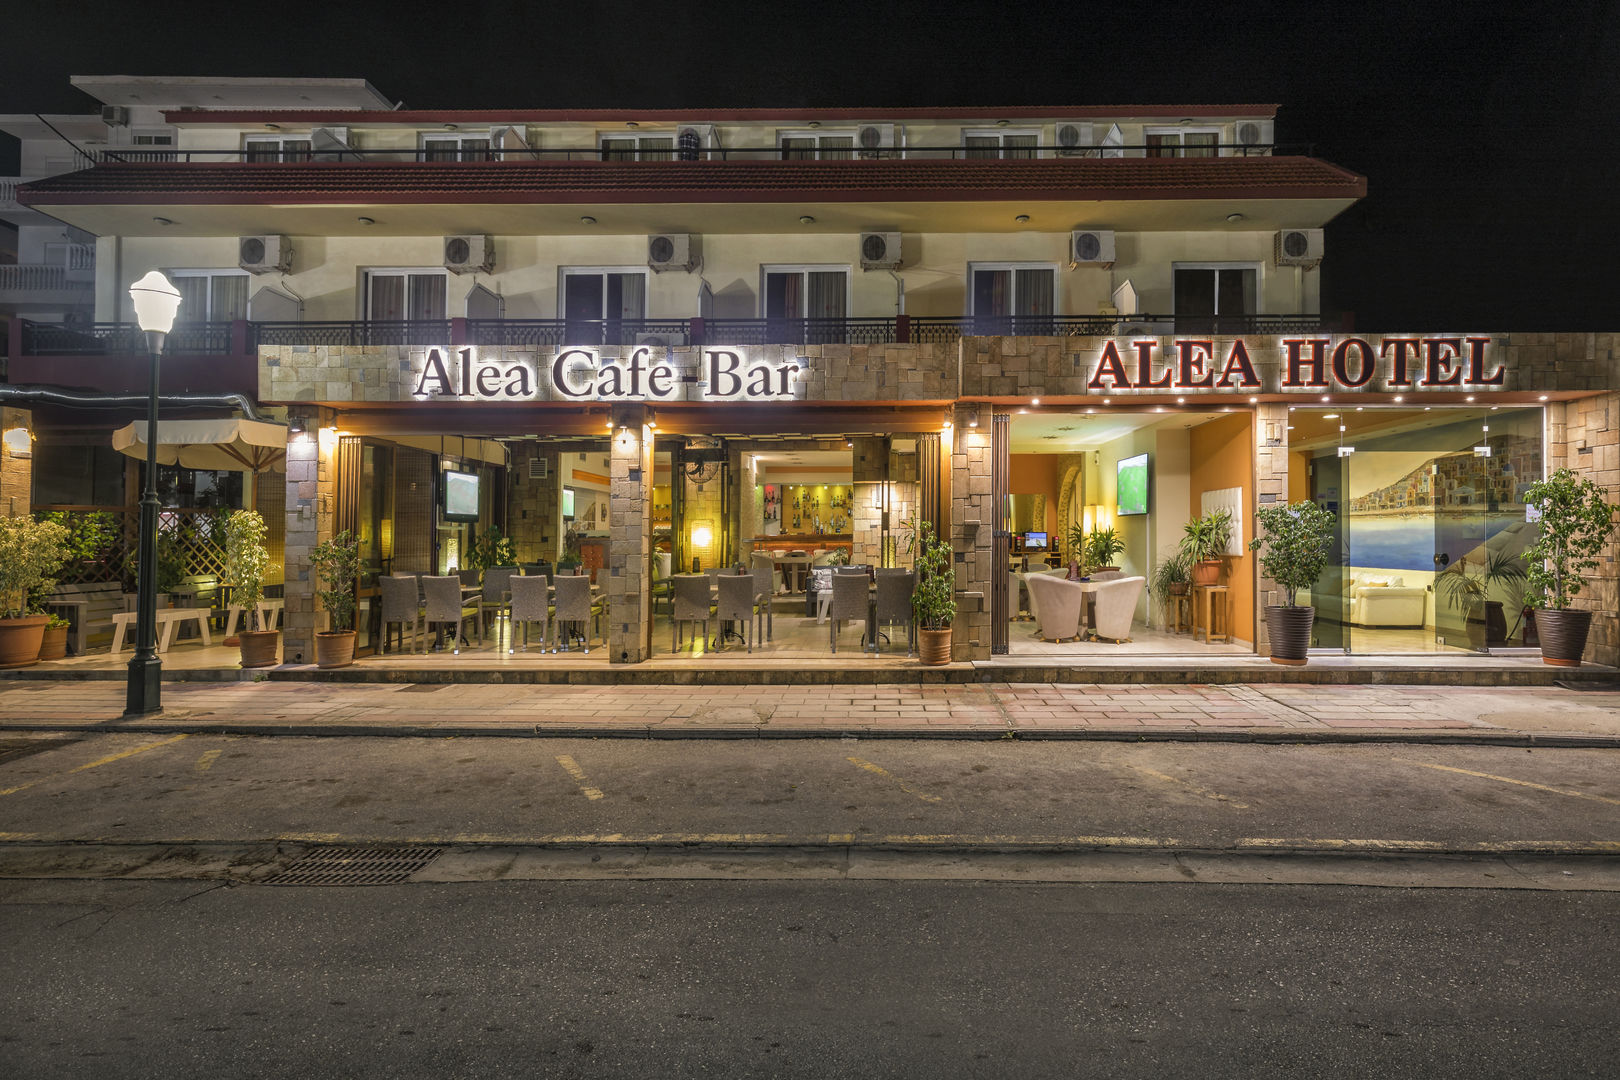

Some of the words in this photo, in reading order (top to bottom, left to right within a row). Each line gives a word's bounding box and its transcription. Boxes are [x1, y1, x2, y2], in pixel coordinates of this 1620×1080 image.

[413, 348, 533, 397] Alea
[553, 347, 673, 397] Cafe
[705, 350, 799, 397] Bar
[1089, 339, 1261, 388] ALEA
[1282, 337, 1505, 387] HOTEL
